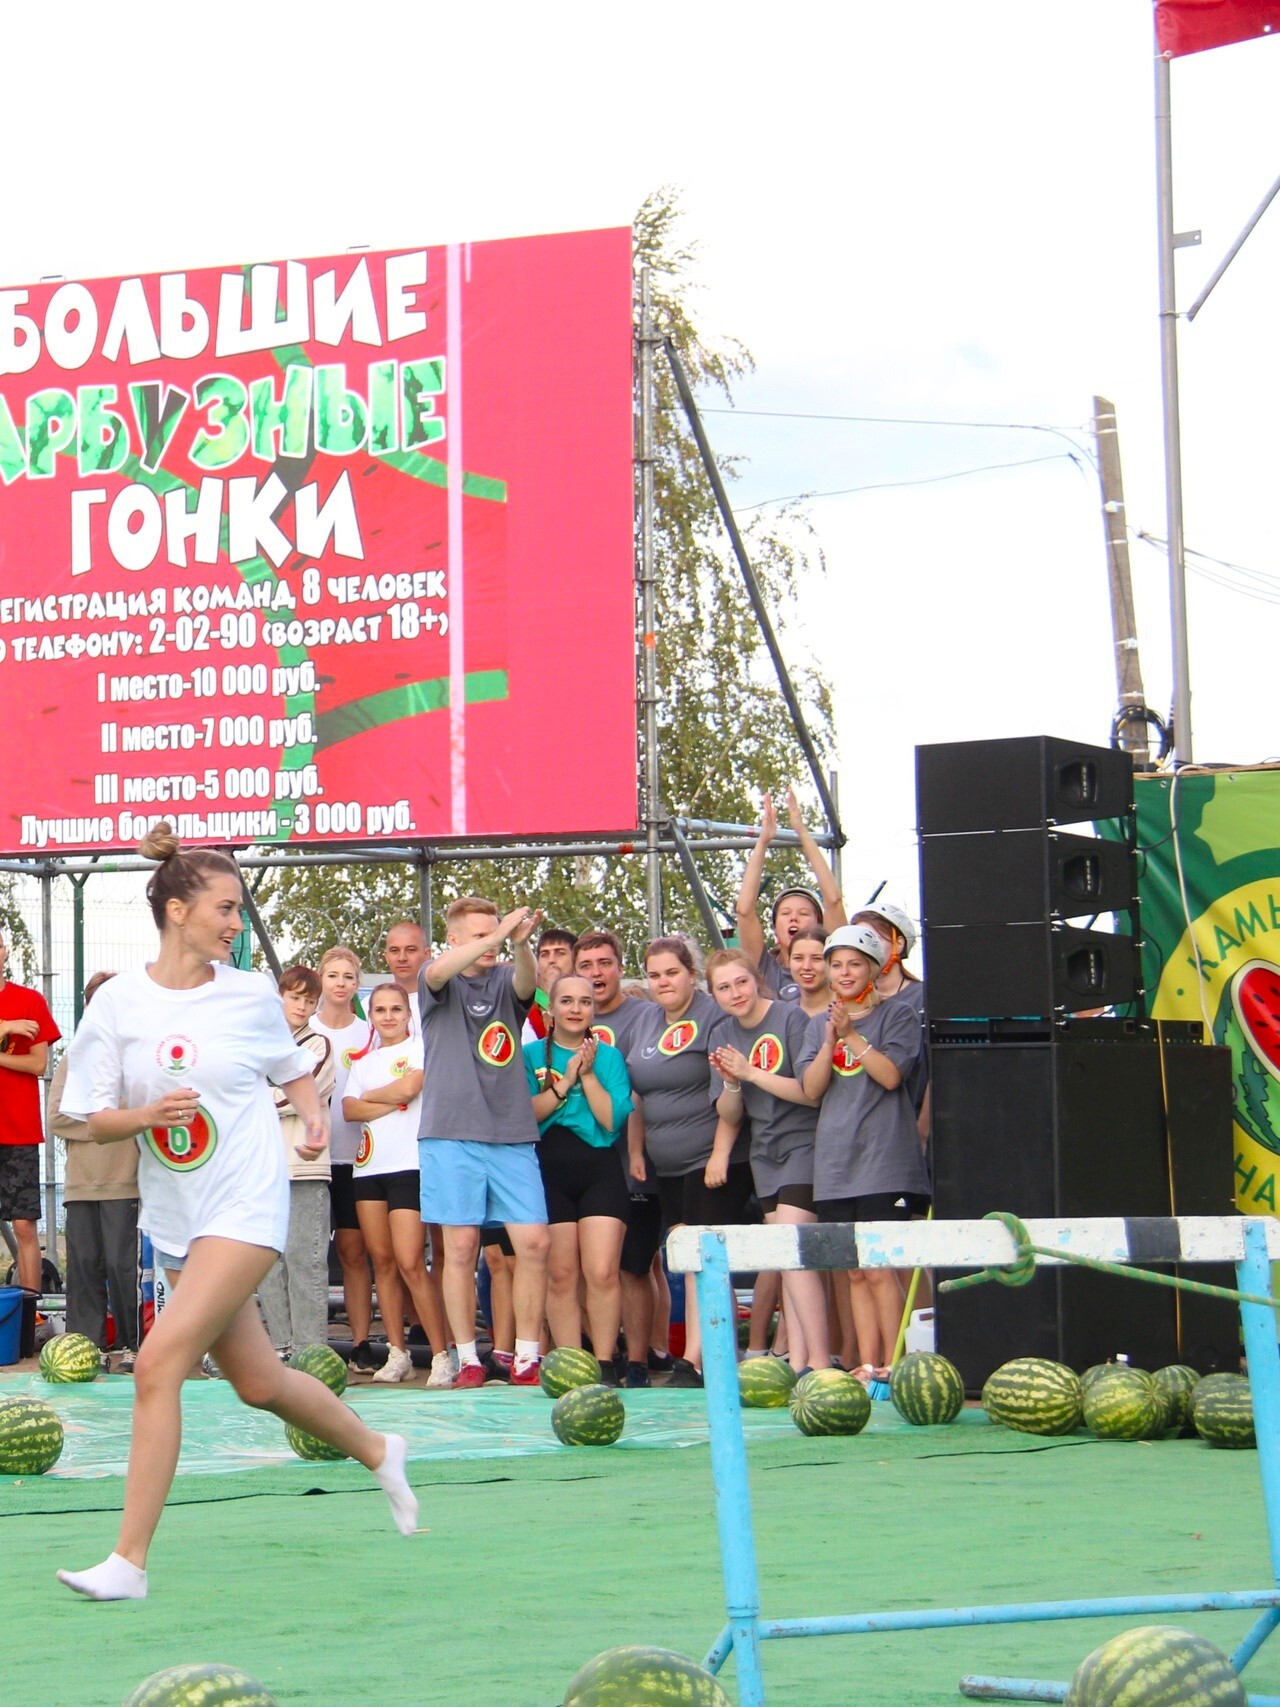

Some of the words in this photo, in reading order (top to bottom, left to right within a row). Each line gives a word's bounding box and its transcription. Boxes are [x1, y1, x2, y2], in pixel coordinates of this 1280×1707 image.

[70, 470, 365, 577] ГОНКИ
[173, 579, 296, 614] КОМАНД
[302, 567, 321, 605] 8
[327, 569, 448, 605] ЧЕЛОВЕК
[11, 630, 144, 662] ТЕЛЕФОНУ:
[148, 611, 257, 655] 2-02-90
[261, 615, 382, 648] (ВОЗРАСТ
[386, 601, 449, 640] 18+)
[110, 665, 217, 702] место-10
[221, 663, 267, 696] 000
[272, 660, 321, 697] руб.
[100, 722, 117, 753] II
[122, 716, 215, 752] место-7
[219, 714, 265, 748] 000
[269, 711, 318, 748] руб.
[94, 773, 119, 805] III
[123, 768, 220, 803] место-5
[224, 766, 270, 799] 000
[274, 763, 324, 800] руб.
[19, 814, 114, 848] Лучшие
[315, 801, 362, 834] 000
[366, 799, 417, 836] руб.
[491, 1032, 506, 1057] 1
[672, 1028, 684, 1048] 1
[758, 1042, 769, 1069] 1
